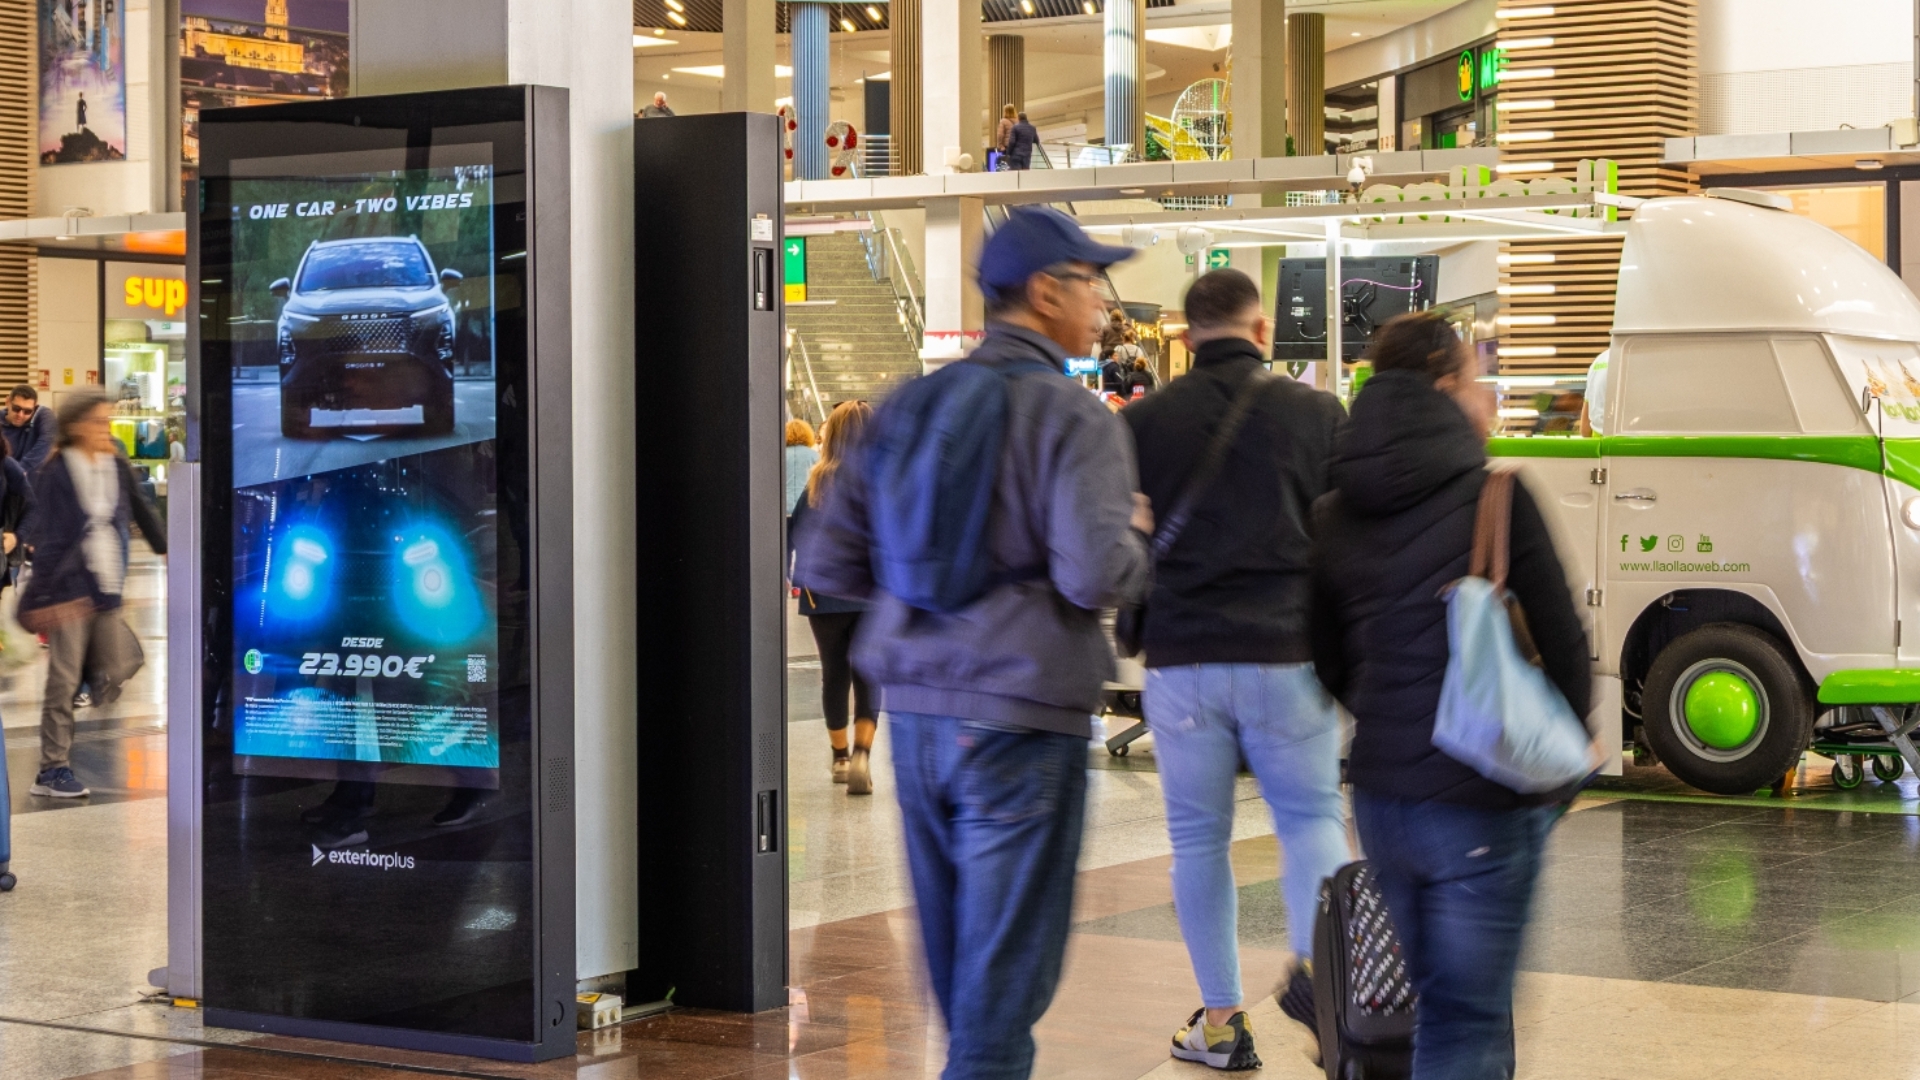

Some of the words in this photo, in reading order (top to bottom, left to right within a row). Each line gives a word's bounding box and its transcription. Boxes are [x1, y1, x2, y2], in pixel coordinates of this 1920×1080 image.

[249, 203, 290, 220] ONE
[295, 201, 335, 218] CAR
[355, 197, 398, 215] TWO
[406, 192, 474, 212] VIBES
[125, 276, 187, 316] sup
[1619, 560, 1751, 573] www.llaollaoweb.com
[341, 636, 385, 649] DESDE
[328, 849, 416, 871] exteriorplus
